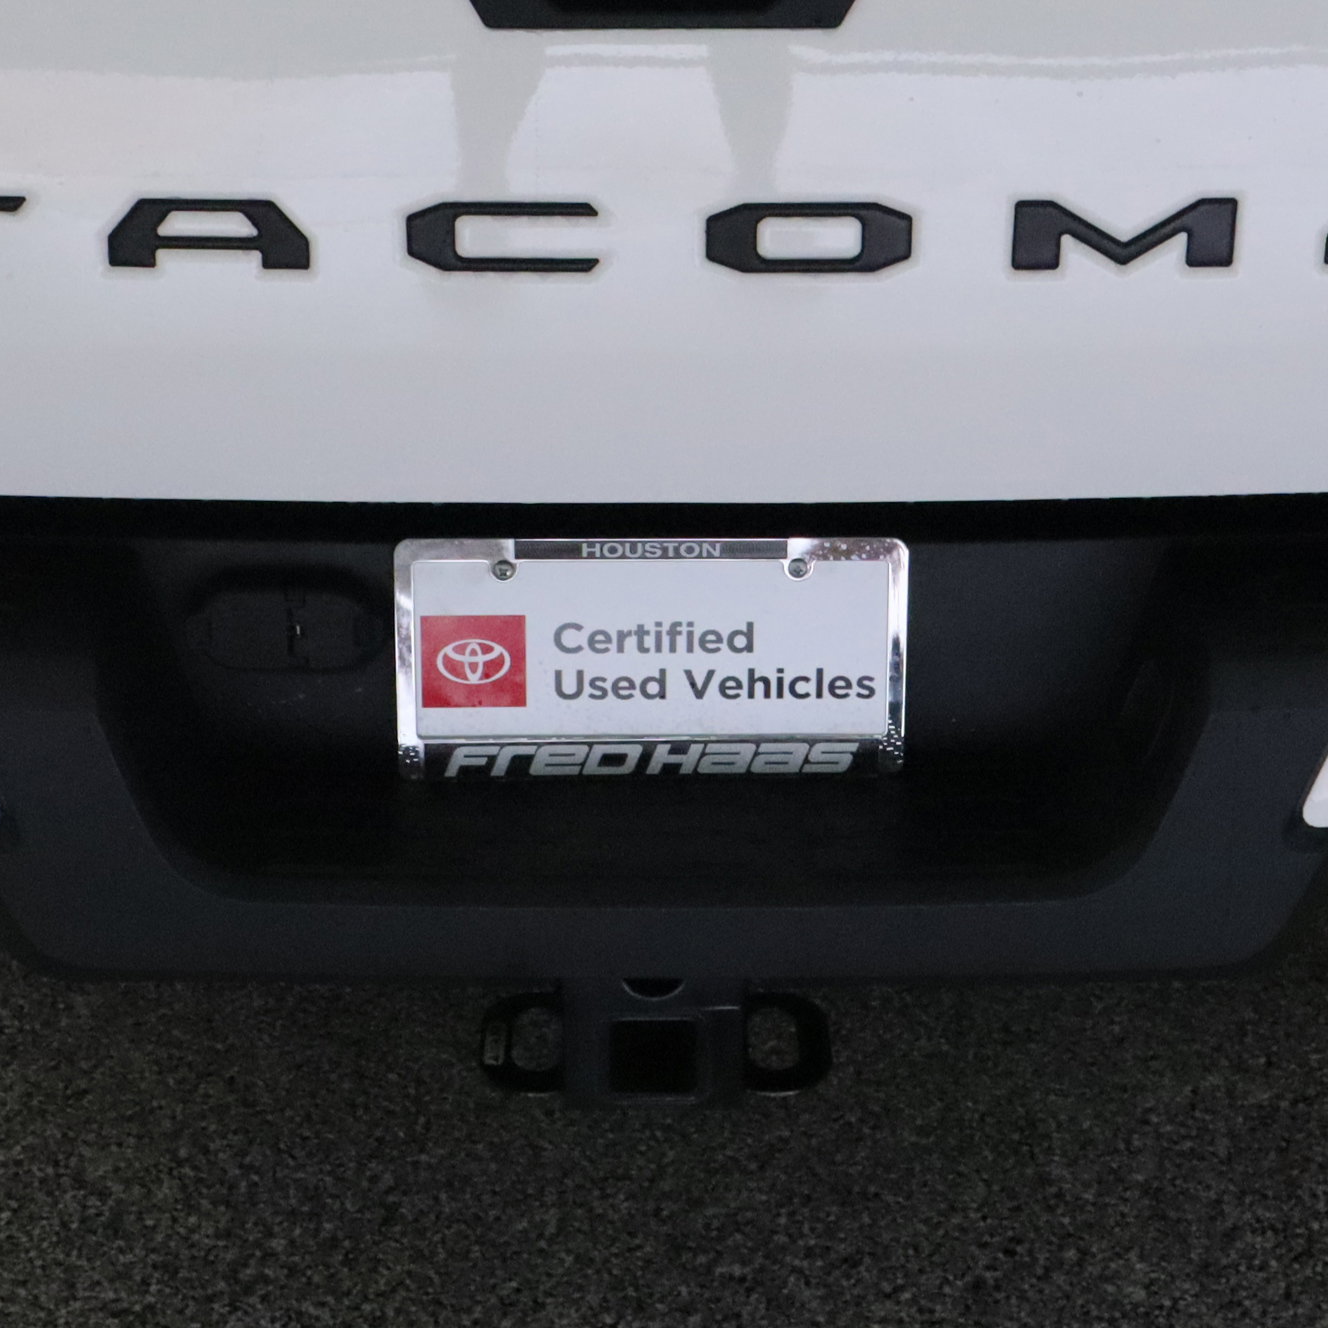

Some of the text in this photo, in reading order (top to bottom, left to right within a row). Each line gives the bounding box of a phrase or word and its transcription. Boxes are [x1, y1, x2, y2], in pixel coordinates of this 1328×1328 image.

[581, 542, 722, 558] HOUSTON
[553, 621, 754, 654] Certified
[554, 668, 876, 700] Used Vehicles
